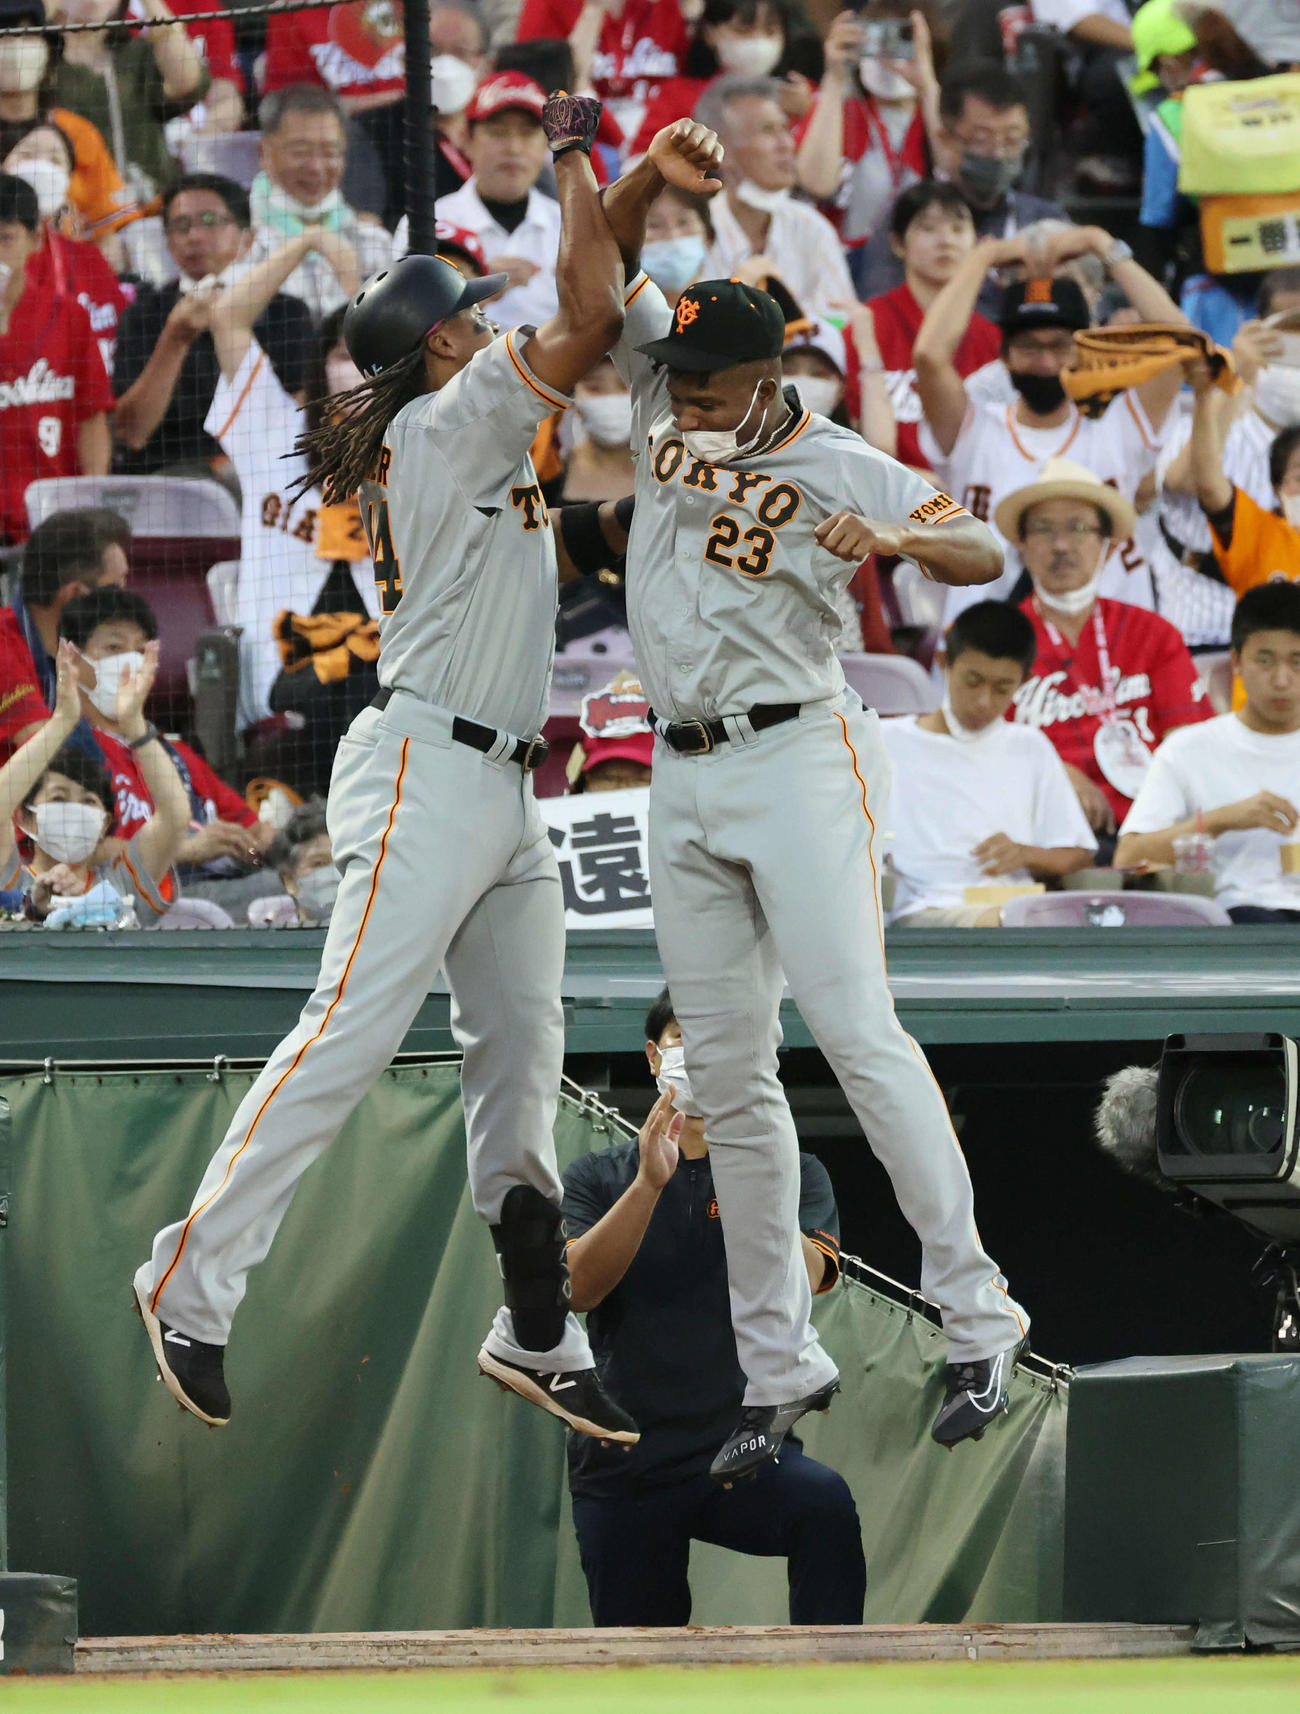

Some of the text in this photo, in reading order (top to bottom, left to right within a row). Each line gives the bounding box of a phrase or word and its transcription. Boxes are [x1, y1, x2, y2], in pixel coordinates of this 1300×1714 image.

[38, 416, 62, 457] 9
[510, 484, 549, 532] T
[647, 434, 803, 530] OKYO
[704, 513, 776, 577] 23
[547, 813, 652, 915] 遠
[723, 1434, 766, 1462] VAPOR
